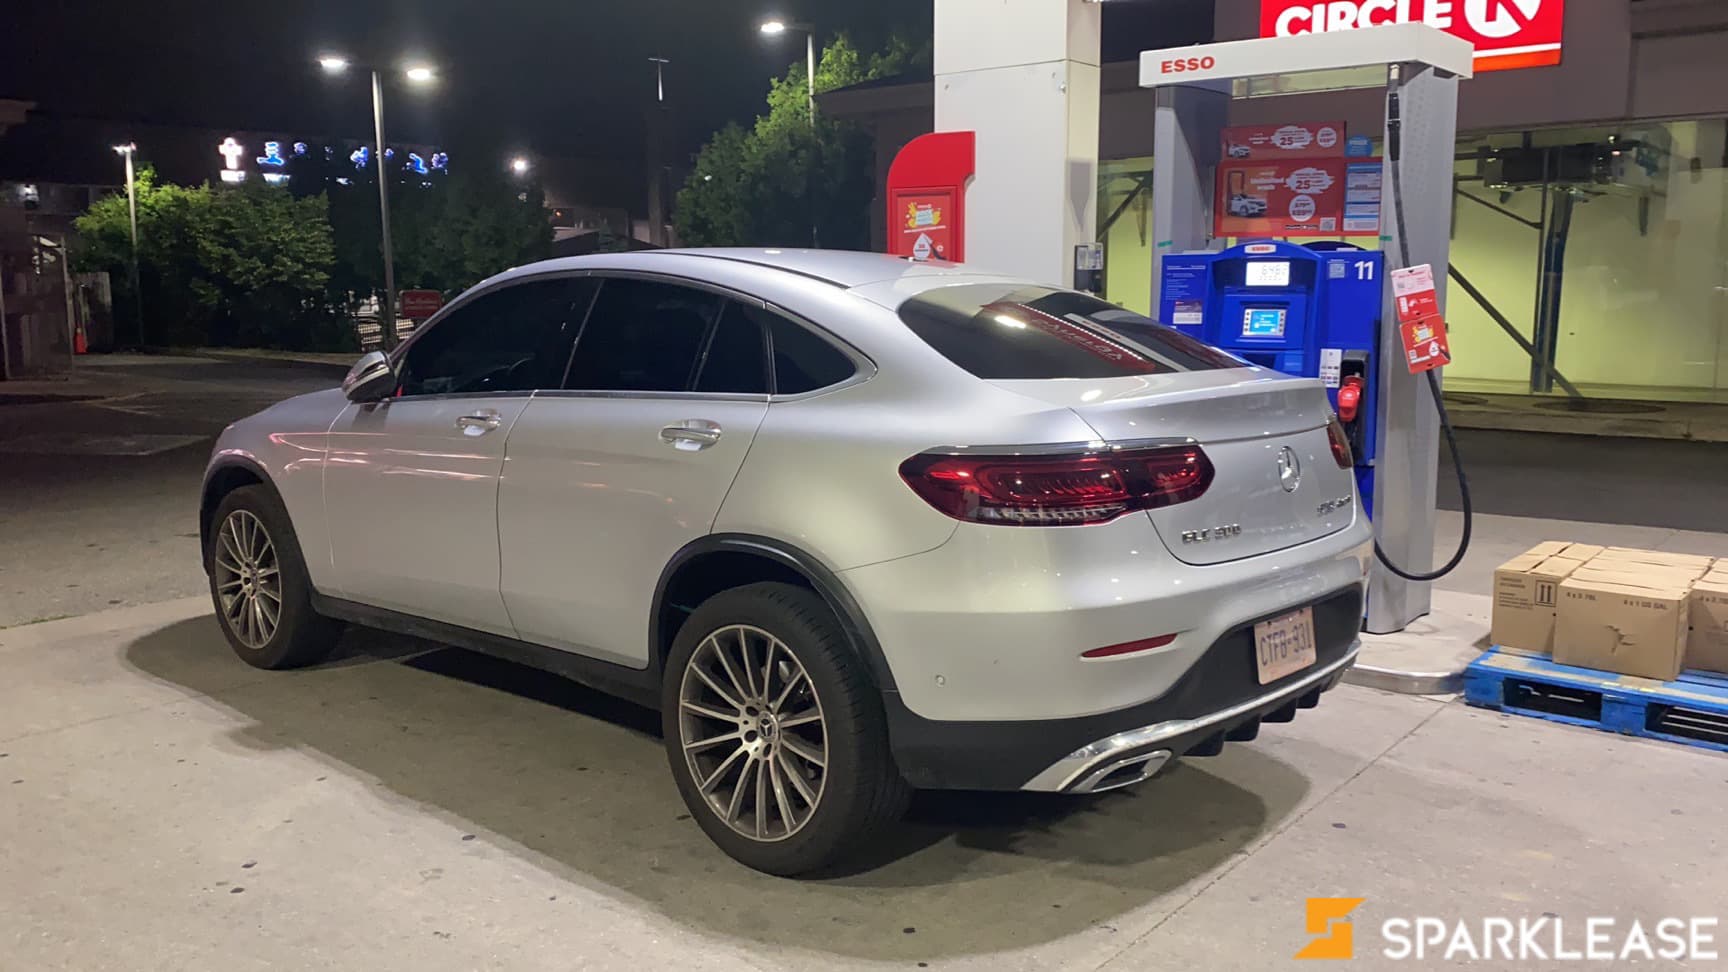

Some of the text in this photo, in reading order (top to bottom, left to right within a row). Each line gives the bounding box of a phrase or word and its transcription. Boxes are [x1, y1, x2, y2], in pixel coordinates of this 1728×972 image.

[1161, 56, 1215, 74] ESSO
[1279, 137, 1294, 146] 25
[1295, 180, 1311, 190] 25
[1354, 261, 1374, 280] 11
